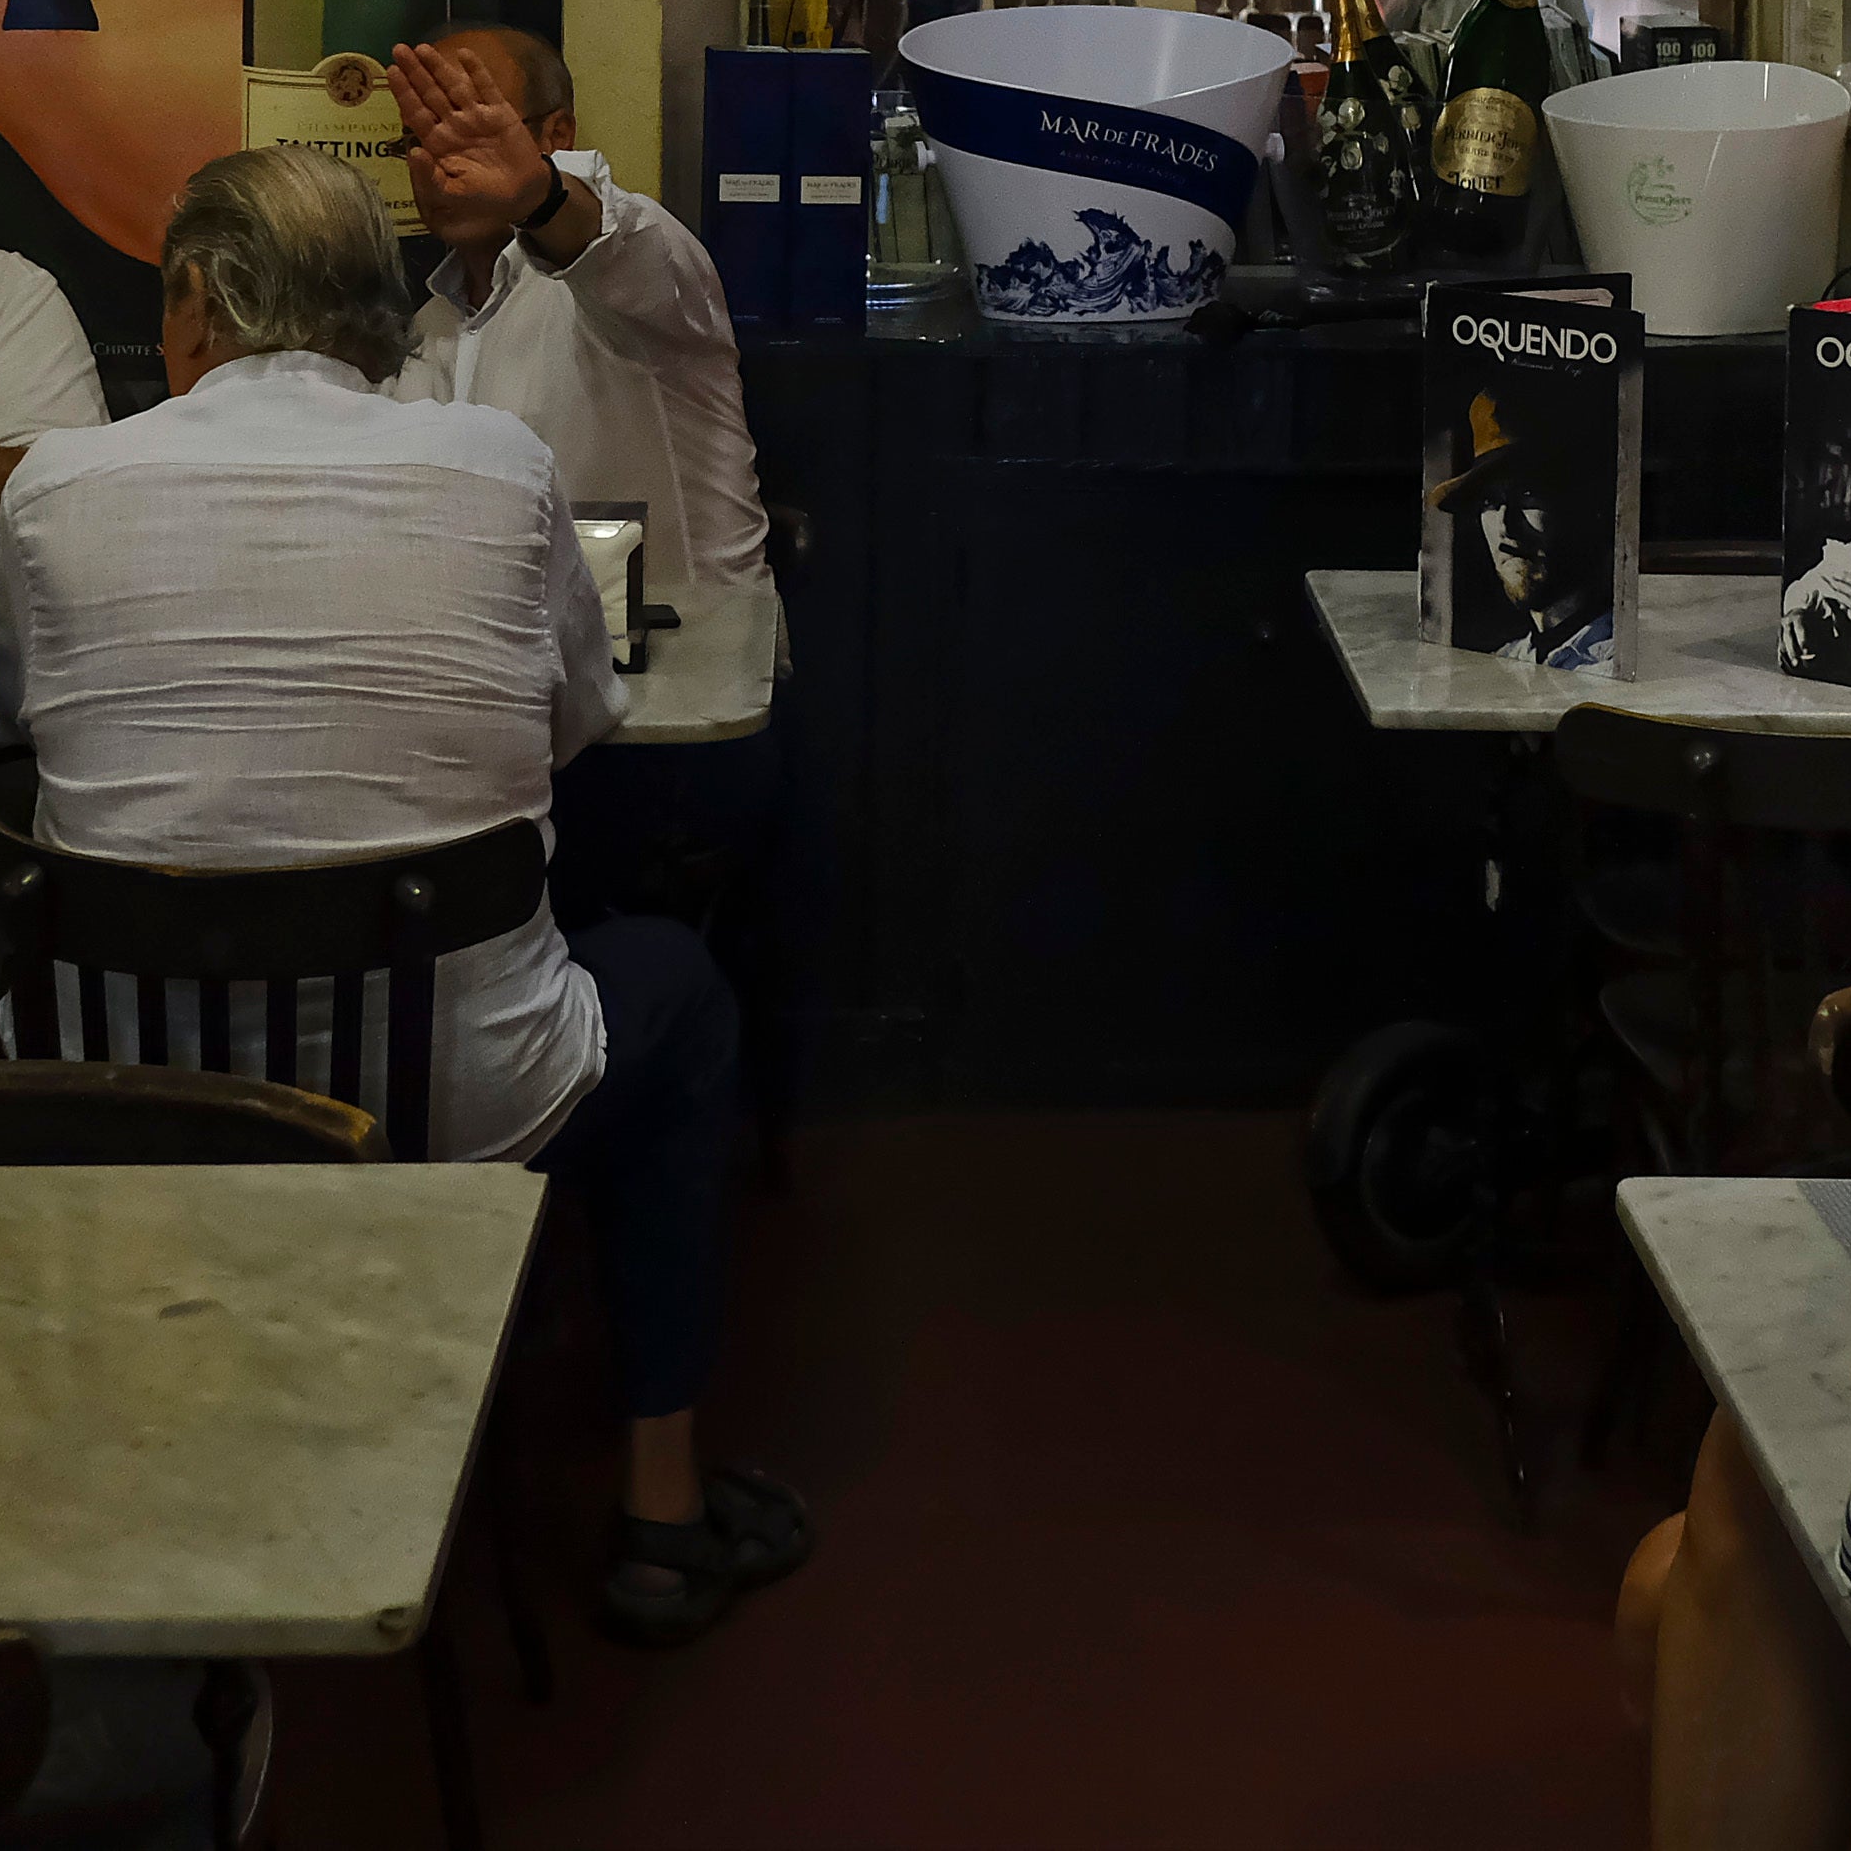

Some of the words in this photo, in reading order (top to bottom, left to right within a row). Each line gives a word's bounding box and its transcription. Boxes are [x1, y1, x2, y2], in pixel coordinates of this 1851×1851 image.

[1656, 42, 1681, 57] 100
[1691, 43, 1716, 58] 100
[1040, 110, 1100, 143] MAR
[1103, 128, 1128, 145] DE
[1130, 130, 1218, 172] FRADES
[1453, 315, 1617, 364] OQUENDO
